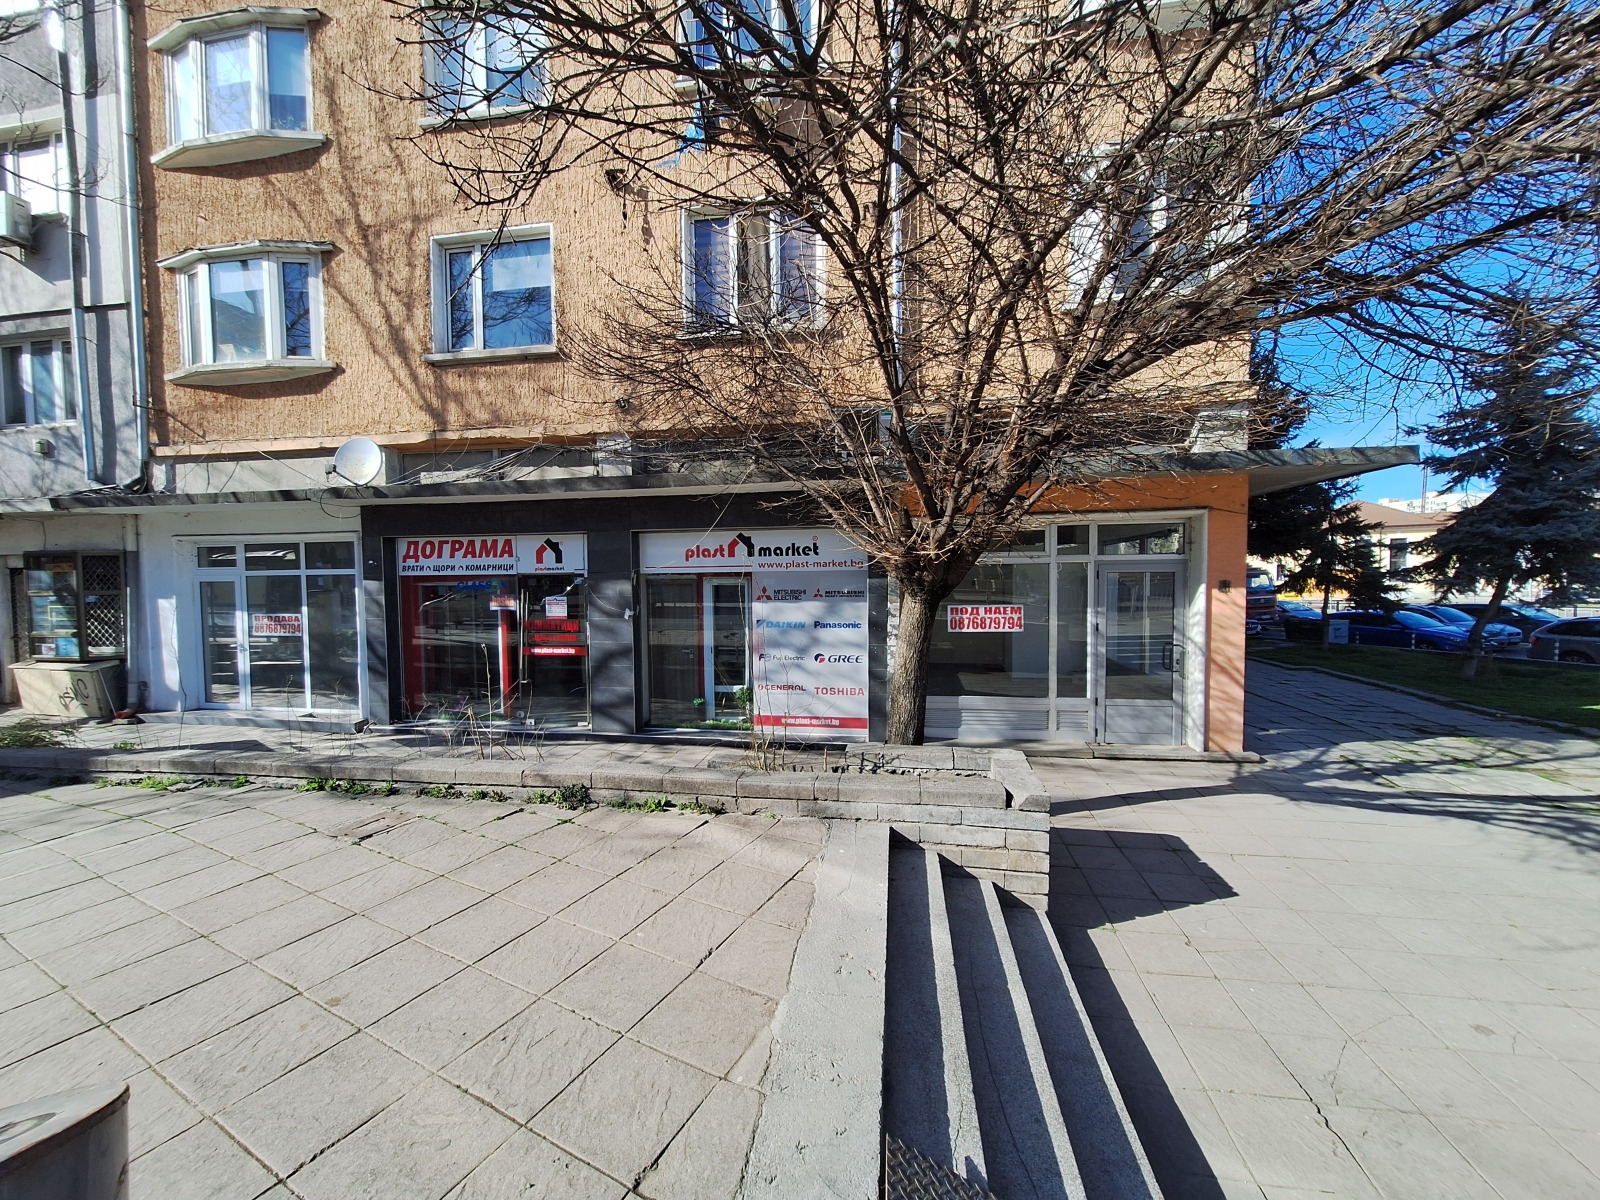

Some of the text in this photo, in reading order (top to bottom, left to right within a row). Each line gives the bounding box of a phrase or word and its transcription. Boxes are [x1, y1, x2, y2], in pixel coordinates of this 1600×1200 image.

[402, 539, 514, 563] ДОГРАМА
[684, 541, 819, 562] plast market
[402, 563, 514, 573] ВРАТИ ЩОРИ КОМАРНИЦИ
[757, 558, 864, 570] www.plast-market.bg
[950, 606, 1022, 616] ПОД НАЕМ
[766, 620, 862, 629] DAIKIN Panasonic
[950, 616, 1022, 629] 0876879794
[254, 623, 301, 633] 0876879794
[828, 654, 864, 664] GREE
[814, 687, 865, 696] TOSHIBA
